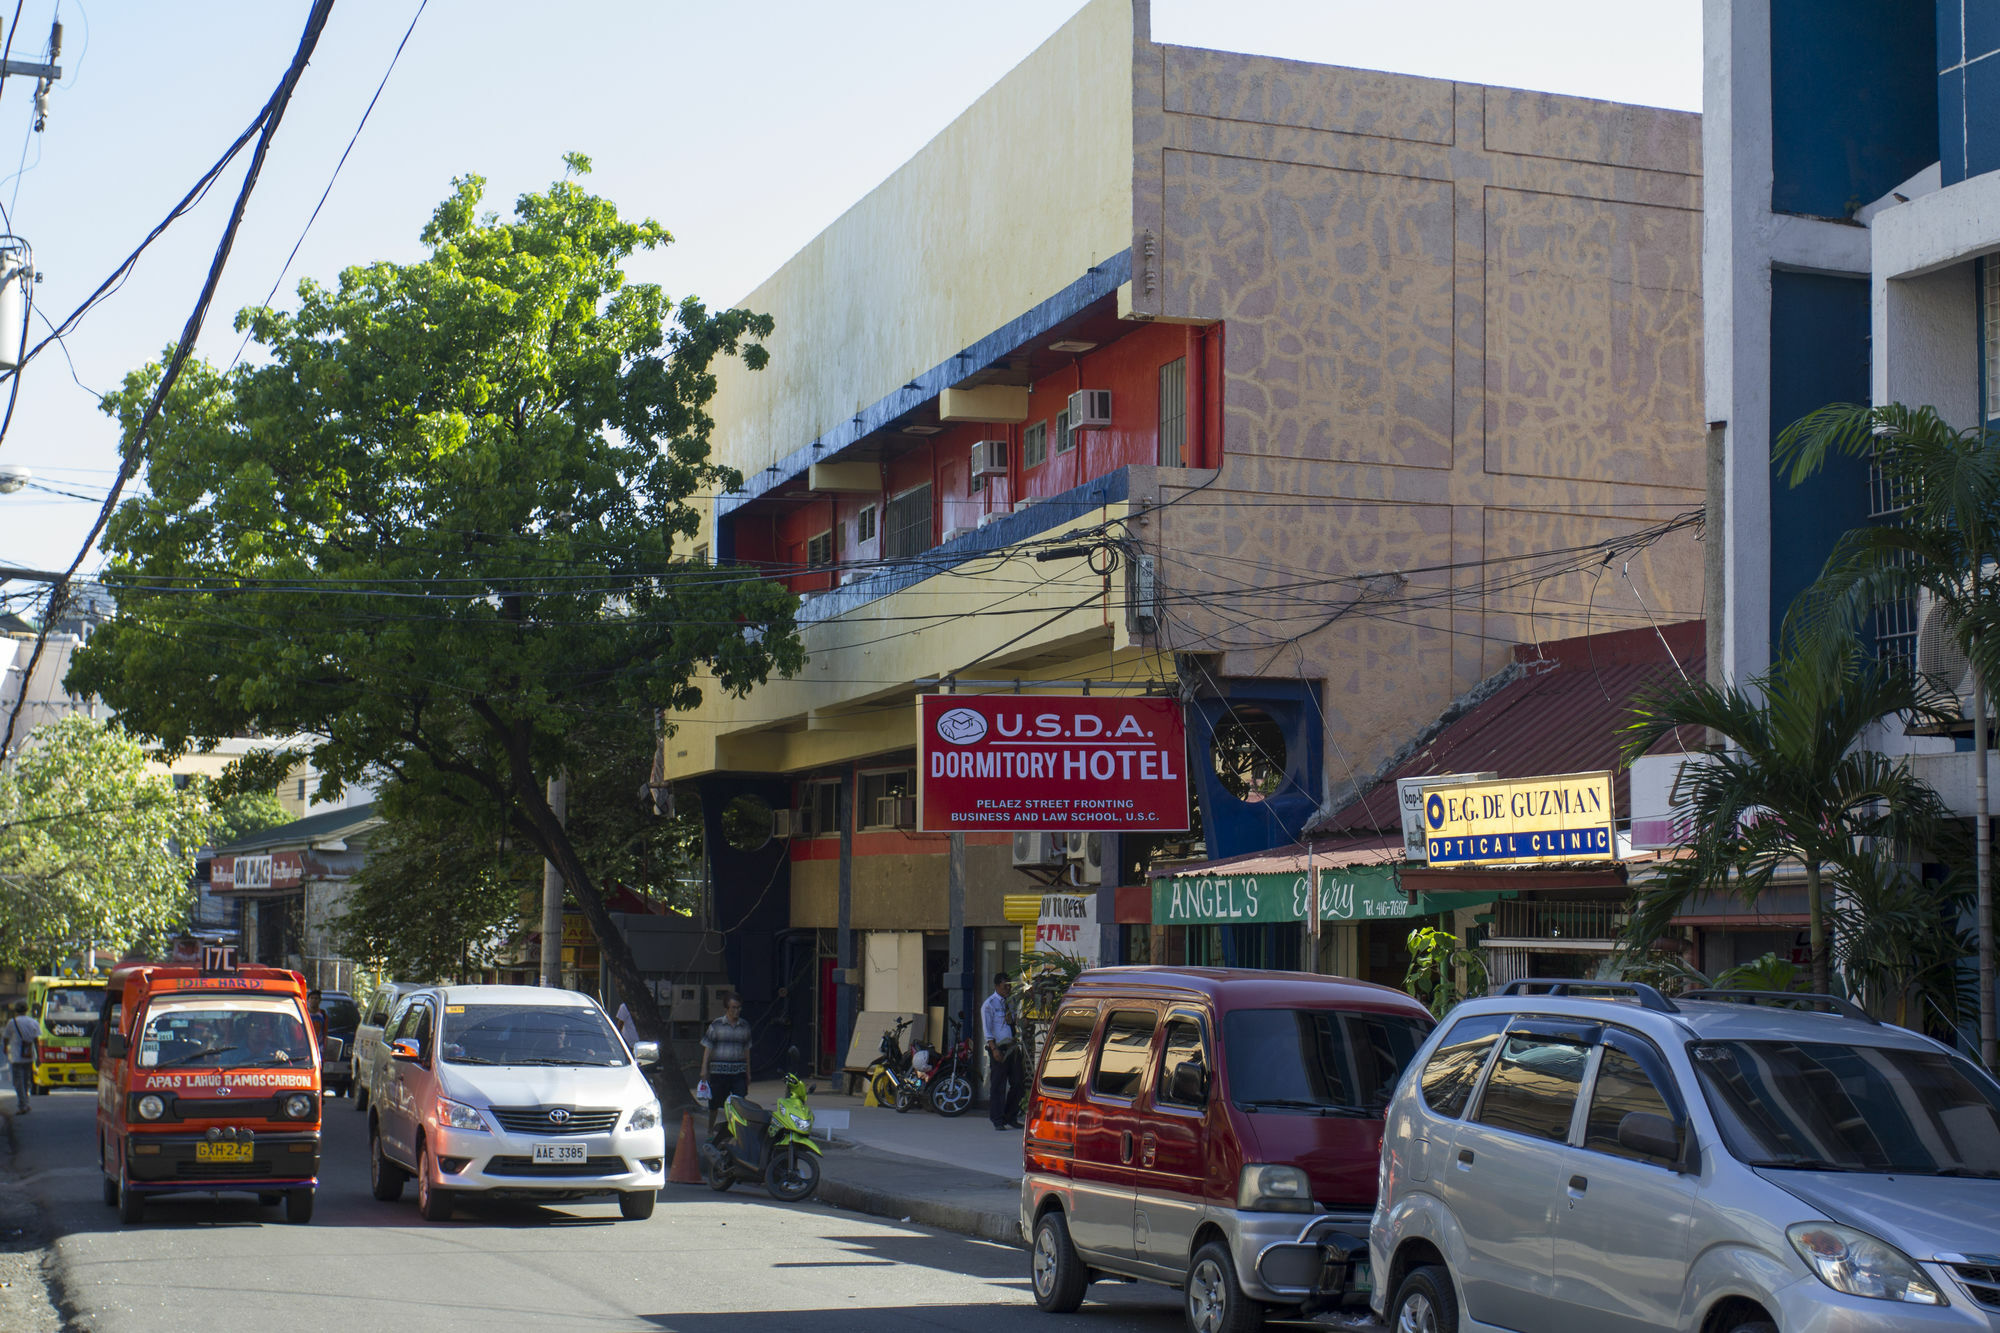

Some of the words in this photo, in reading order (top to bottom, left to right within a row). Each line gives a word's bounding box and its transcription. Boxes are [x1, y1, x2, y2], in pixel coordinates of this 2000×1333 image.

[996, 713, 1154, 737] U.S.D.A.
[931, 751, 1058, 779] DORMITORY
[1063, 750, 1177, 780] HOTEL
[976, 799, 1022, 809] PELAEZ
[1025, 799, 1071, 809] STREET
[1073, 799, 1134, 809] FRONTING
[1447, 797, 1479, 822] E.G.
[1482, 794, 1506, 820] DE
[1511, 786, 1601, 819] GUZMAN
[951, 812, 1011, 822] BUSINESS
[1014, 812, 1039, 822] AND
[1042, 812, 1068, 822] LAW
[1071, 812, 1123, 823] SCHOOL,
[1125, 812, 1160, 822] U.S.C.
[1430, 835, 1517, 857] OPTICAL
[1531, 830, 1607, 851] CLINIC
[1064, 897, 1087, 917] OPEN
[1169, 877, 1259, 919] ANGEL'S
[205, 947, 235, 971] 17C
[145, 1075, 182, 1088] APAS
[186, 1075, 222, 1087] LAHUG
[224, 1075, 266, 1087] RAMOS
[267, 1075, 312, 1087] CARBON
[536, 1147, 554, 1158] AAE
[559, 1147, 583, 1158] 3385
